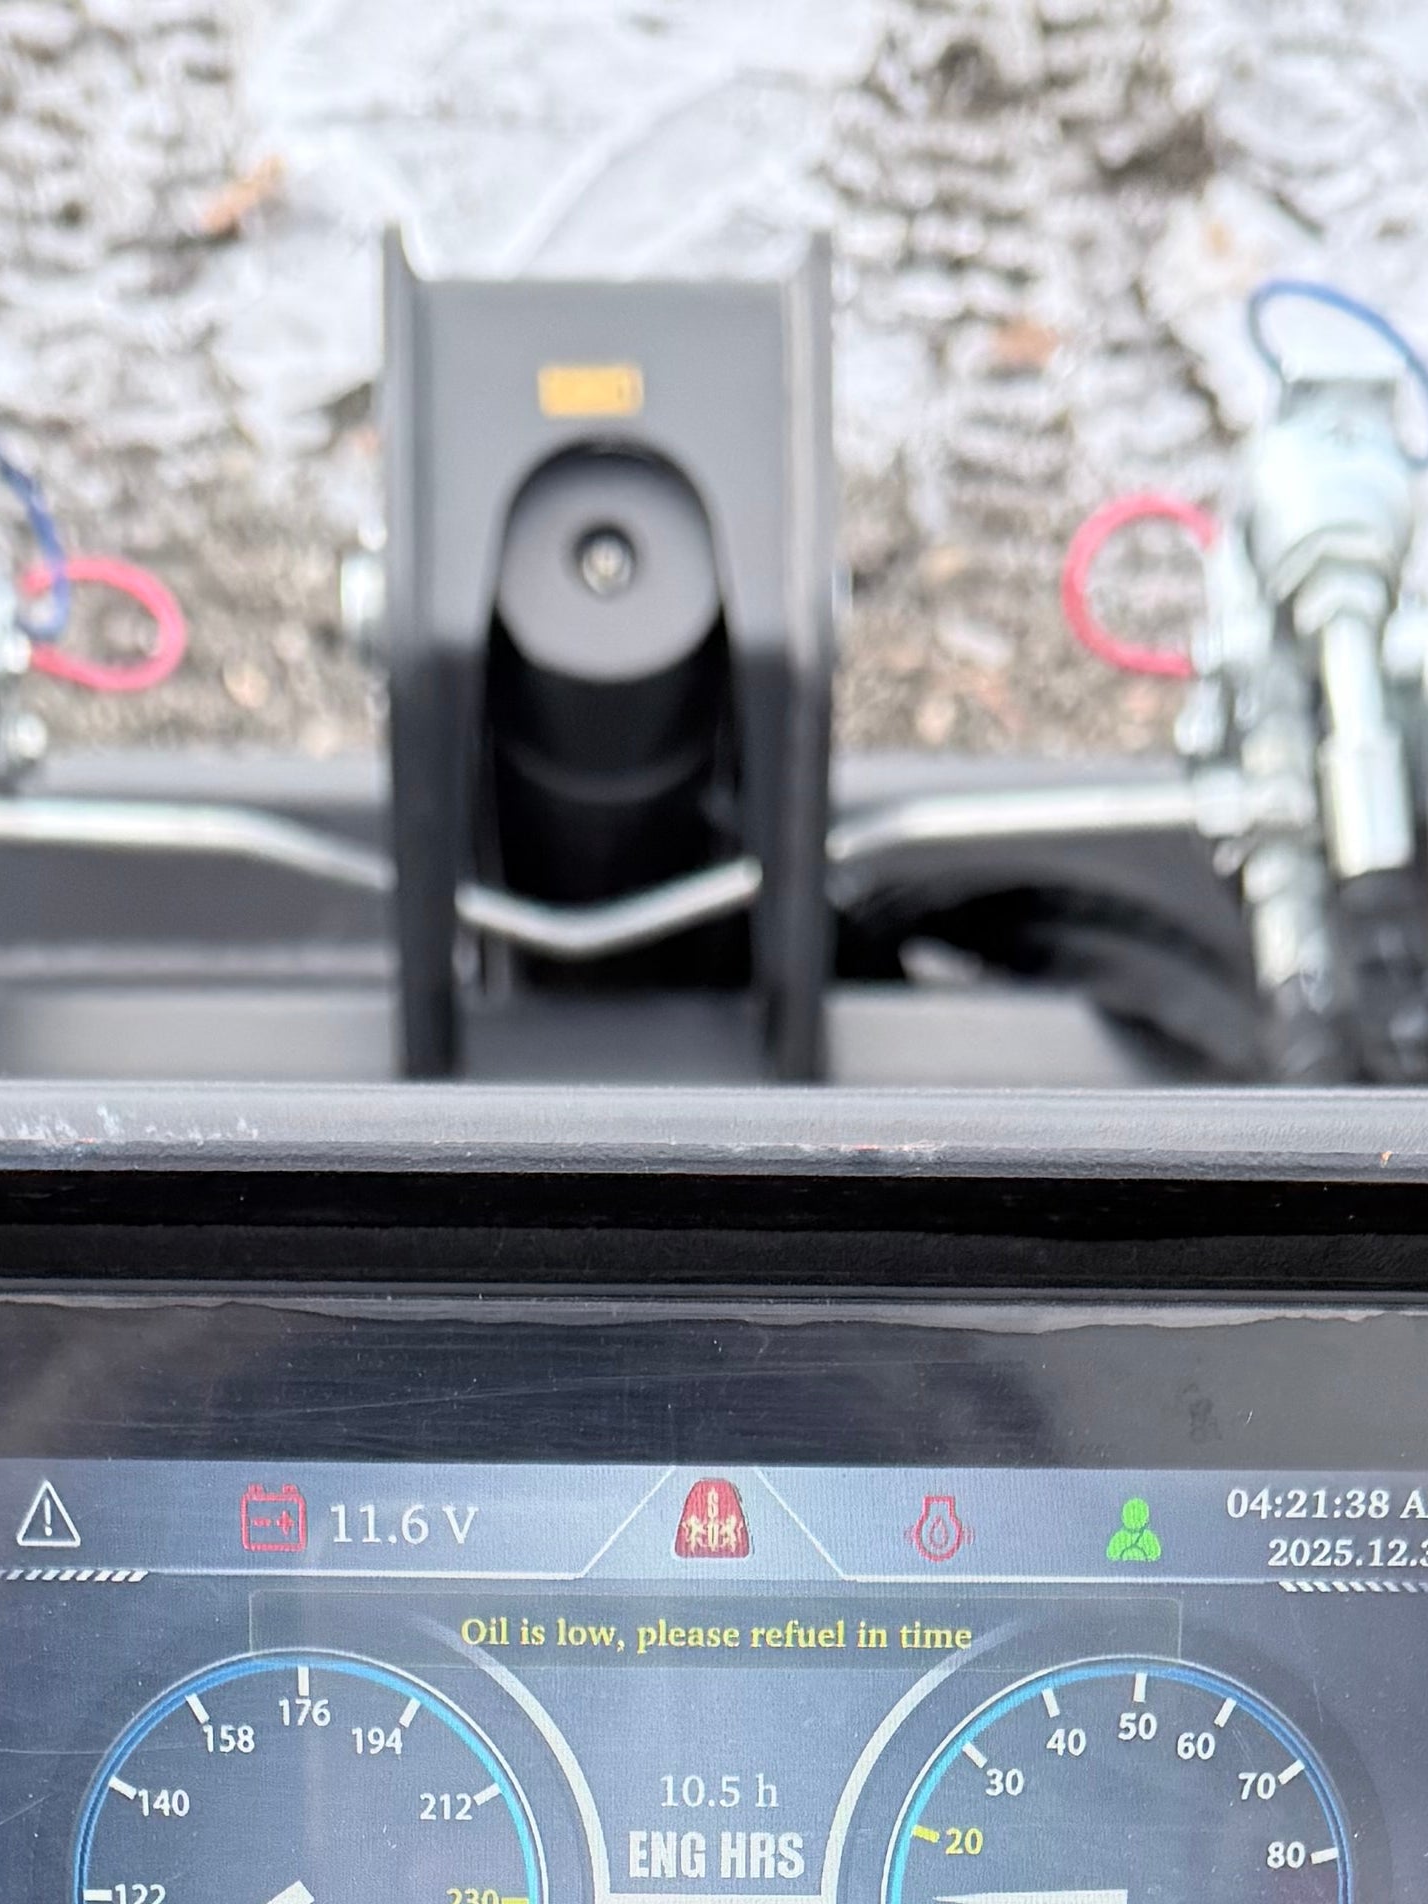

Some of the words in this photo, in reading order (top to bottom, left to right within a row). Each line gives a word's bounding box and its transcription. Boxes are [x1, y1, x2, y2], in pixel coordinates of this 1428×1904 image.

[1226, 1488, 1390, 1520] 04:21:38
[330, 1503, 429, 1545] 11.6
[443, 1506, 479, 1545] V
[461, 1617, 510, 1646] Oil
[520, 1618, 545, 1646] is
[557, 1617, 625, 1653] low,
[637, 1618, 740, 1654] please
[750, 1620, 845, 1648] refuel
[857, 1620, 888, 1649] in
[900, 1622, 972, 1650] time
[279, 1699, 331, 1727] 176
[1118, 1712, 1157, 1741] 50
[202, 1724, 256, 1754] 158
[351, 1727, 403, 1755] 194
[1046, 1728, 1086, 1758] 40
[1177, 1732, 1215, 1761] 60
[660, 1775, 740, 1808] 10.5
[755, 1772, 779, 1808] h
[985, 1769, 1024, 1797] 30
[1238, 1772, 1276, 1800] 70
[136, 1789, 190, 1817] 140
[420, 1793, 473, 1821] 212
[629, 1831, 706, 1878] ENG
[721, 1831, 805, 1879] HRS
[945, 1828, 983, 1855] 20
[1267, 1841, 1306, 1869] 80
